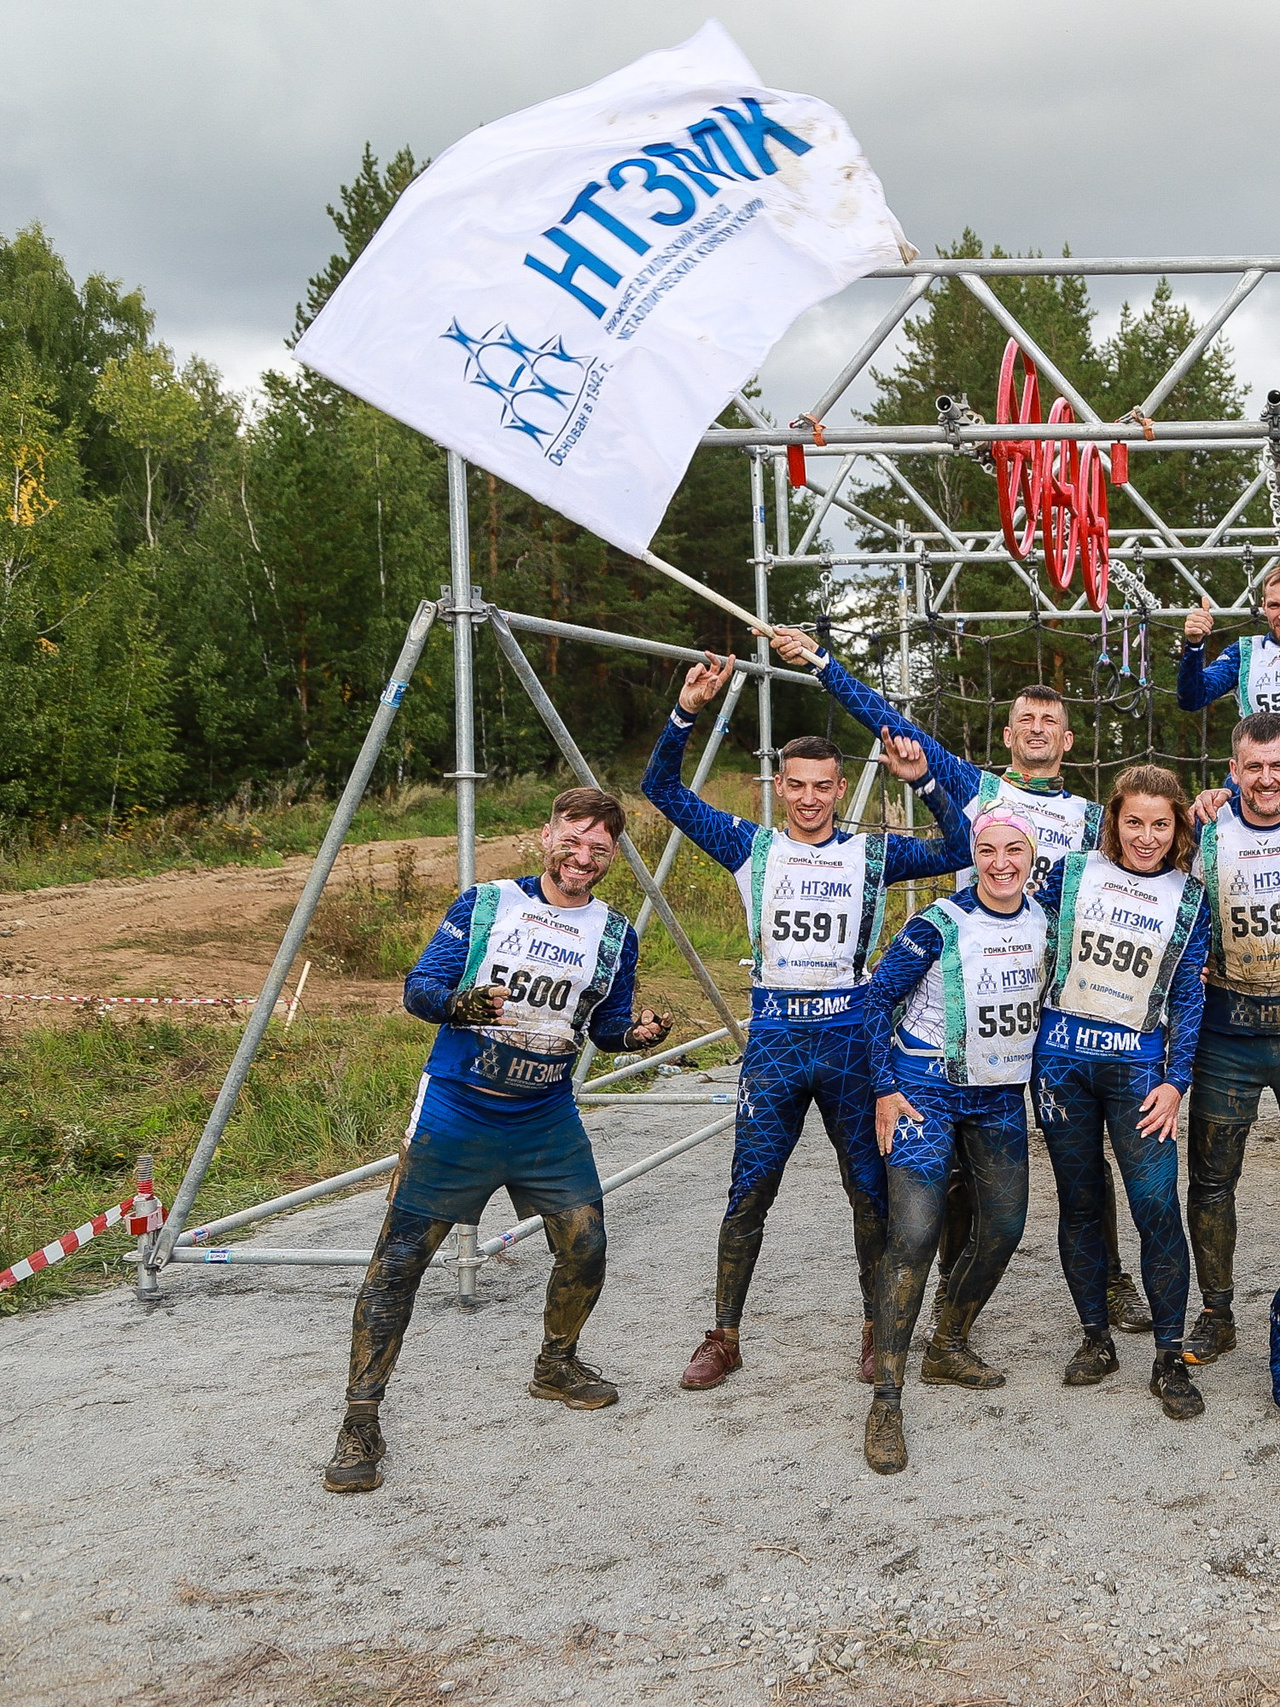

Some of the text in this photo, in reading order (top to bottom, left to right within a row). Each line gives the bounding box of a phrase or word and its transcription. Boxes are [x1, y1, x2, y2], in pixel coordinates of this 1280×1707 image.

[523, 97, 813, 321] НТЗМК
[1035, 826, 1073, 850] ТЗМК
[814, 859, 843, 867] ГЕРОЕВ
[1239, 848, 1262, 857] ГОНКА
[801, 880, 852, 898] НТЗМК
[1103, 881, 1158, 902] ГОНКА ГЕРОЕВ
[522, 912, 580, 935] ГОНКА ГЕРОЕВ
[771, 910, 848, 944] 5591
[1110, 906, 1164, 934] НТЗМК
[528, 938, 586, 968] НТЗМК
[983, 943, 1032, 955] ГОНКА ГЕРОЕВ
[1077, 930, 1154, 979] 5596
[790, 960, 838, 969] ГАЗПРОМБАНК
[489, 964, 572, 1012] 5600
[1089, 983, 1135, 1003] ГАЗПРОМБАНК
[787, 994, 851, 1016] НТЗМК
[1075, 1026, 1142, 1052] НТЗМК
